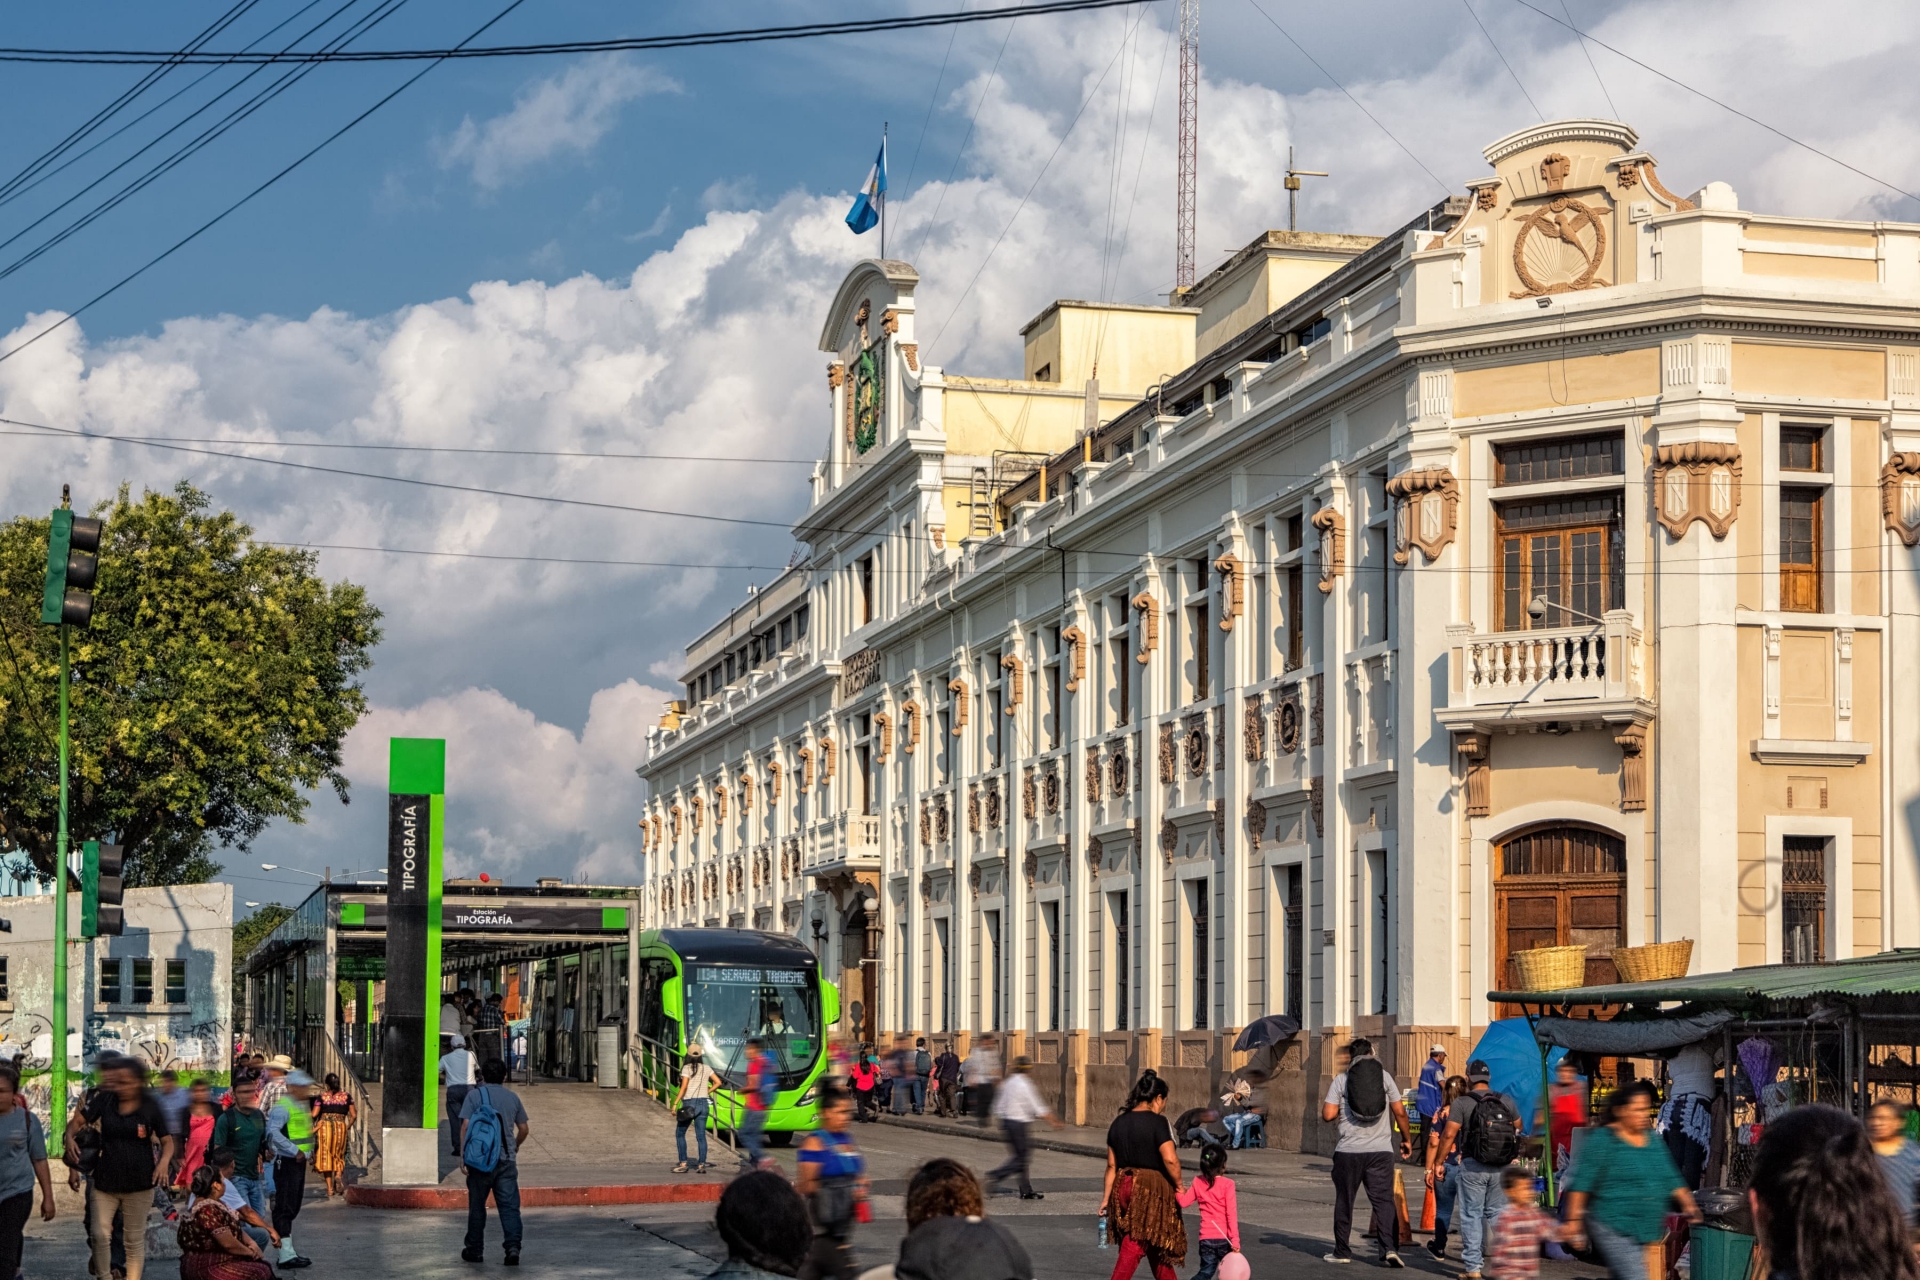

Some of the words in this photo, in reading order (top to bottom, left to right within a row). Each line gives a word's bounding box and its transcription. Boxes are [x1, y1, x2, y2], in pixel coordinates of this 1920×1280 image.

[400, 805, 417, 891] TIPOGRAFÍA
[456, 914, 513, 925] TIPOGRAFÍA
[722, 968, 761, 982] SERVICIO
